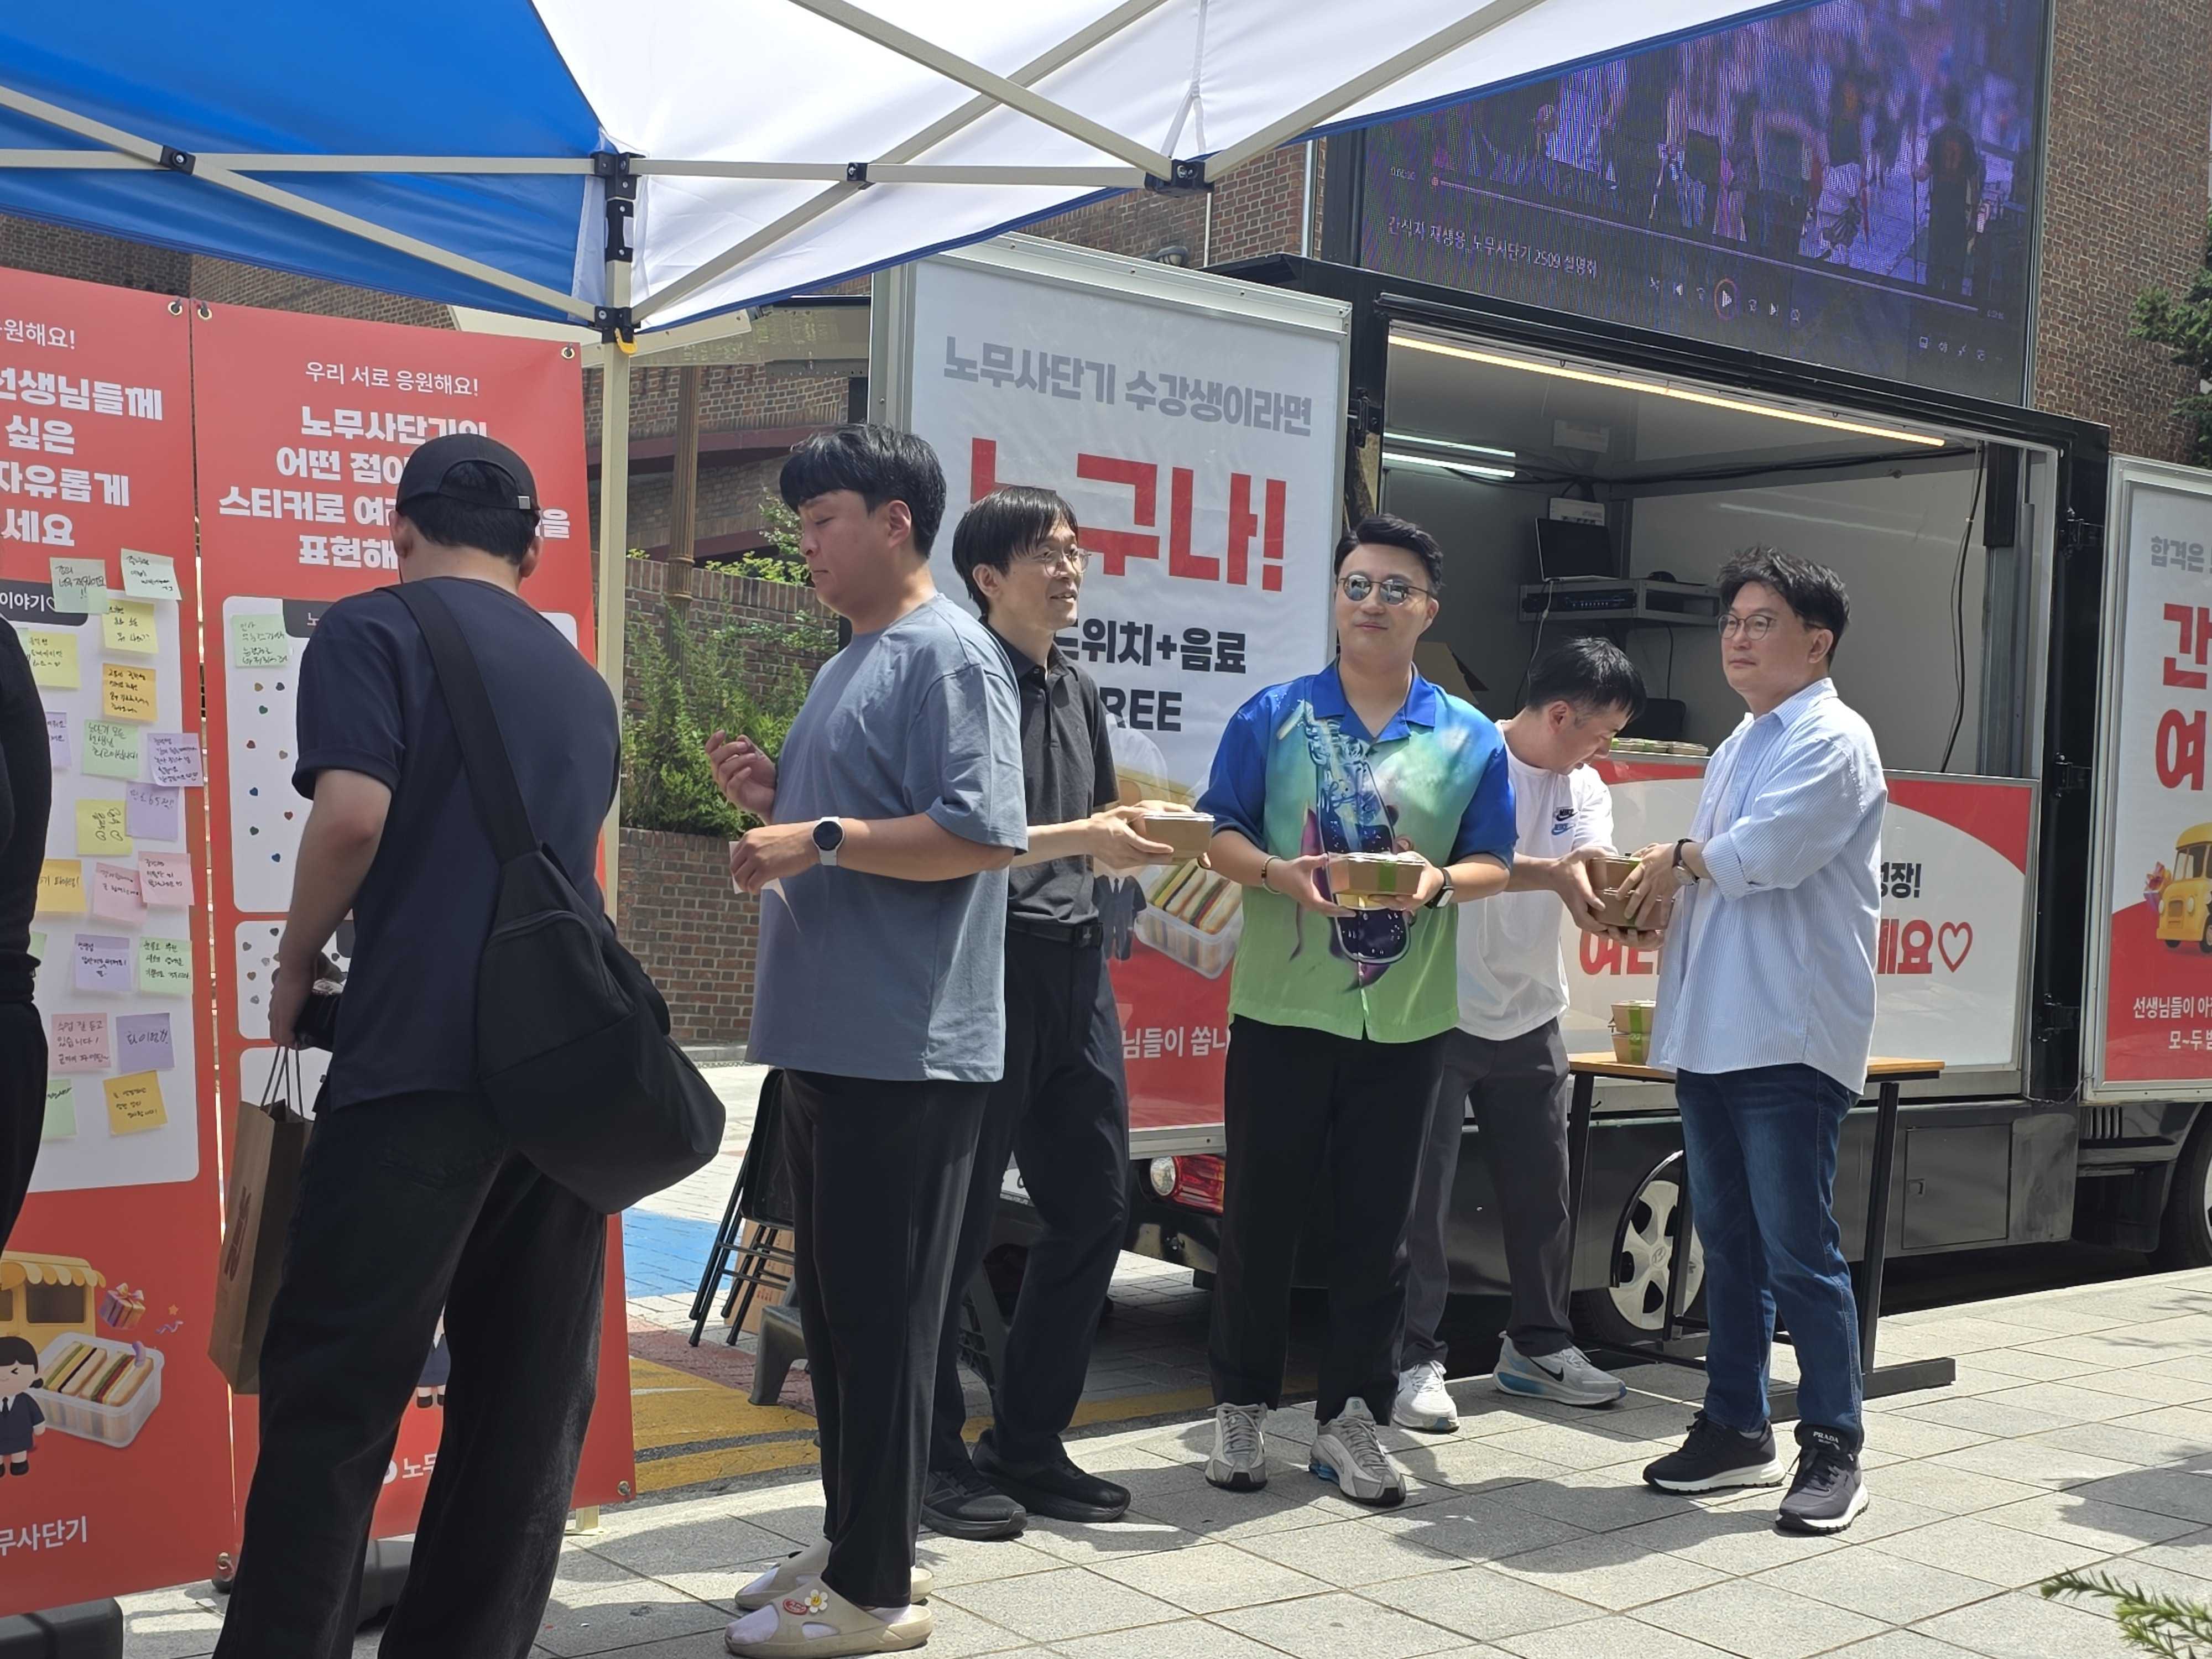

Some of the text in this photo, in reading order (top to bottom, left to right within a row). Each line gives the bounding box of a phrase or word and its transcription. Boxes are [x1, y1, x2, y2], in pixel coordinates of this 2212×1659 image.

[0, 319, 75, 349] 원해요!
[306, 361, 479, 397] 우리 서로 응원해요!
[943, 336, 1313, 437] 노무사단기 수강생이라면
[6, 415, 75, 455] 싶은
[276, 446, 341, 481] 어떤
[0, 461, 129, 507] 자유롭게
[219, 486, 346, 524] 스티커로
[535, 508, 570, 539] 을
[299, 534, 399, 570] 표현해
[2150, 535, 2205, 573] 합격은
[1099, 687, 1182, 732] REE
[2155, 708, 2206, 791] 여
[2133, 996, 2195, 1019] 선생님들이
[1121, 1026, 1231, 1060] 님들이 쏩니
[2168, 1030, 2203, 1051] 모~두
[401, 1452, 438, 1479] 노무
